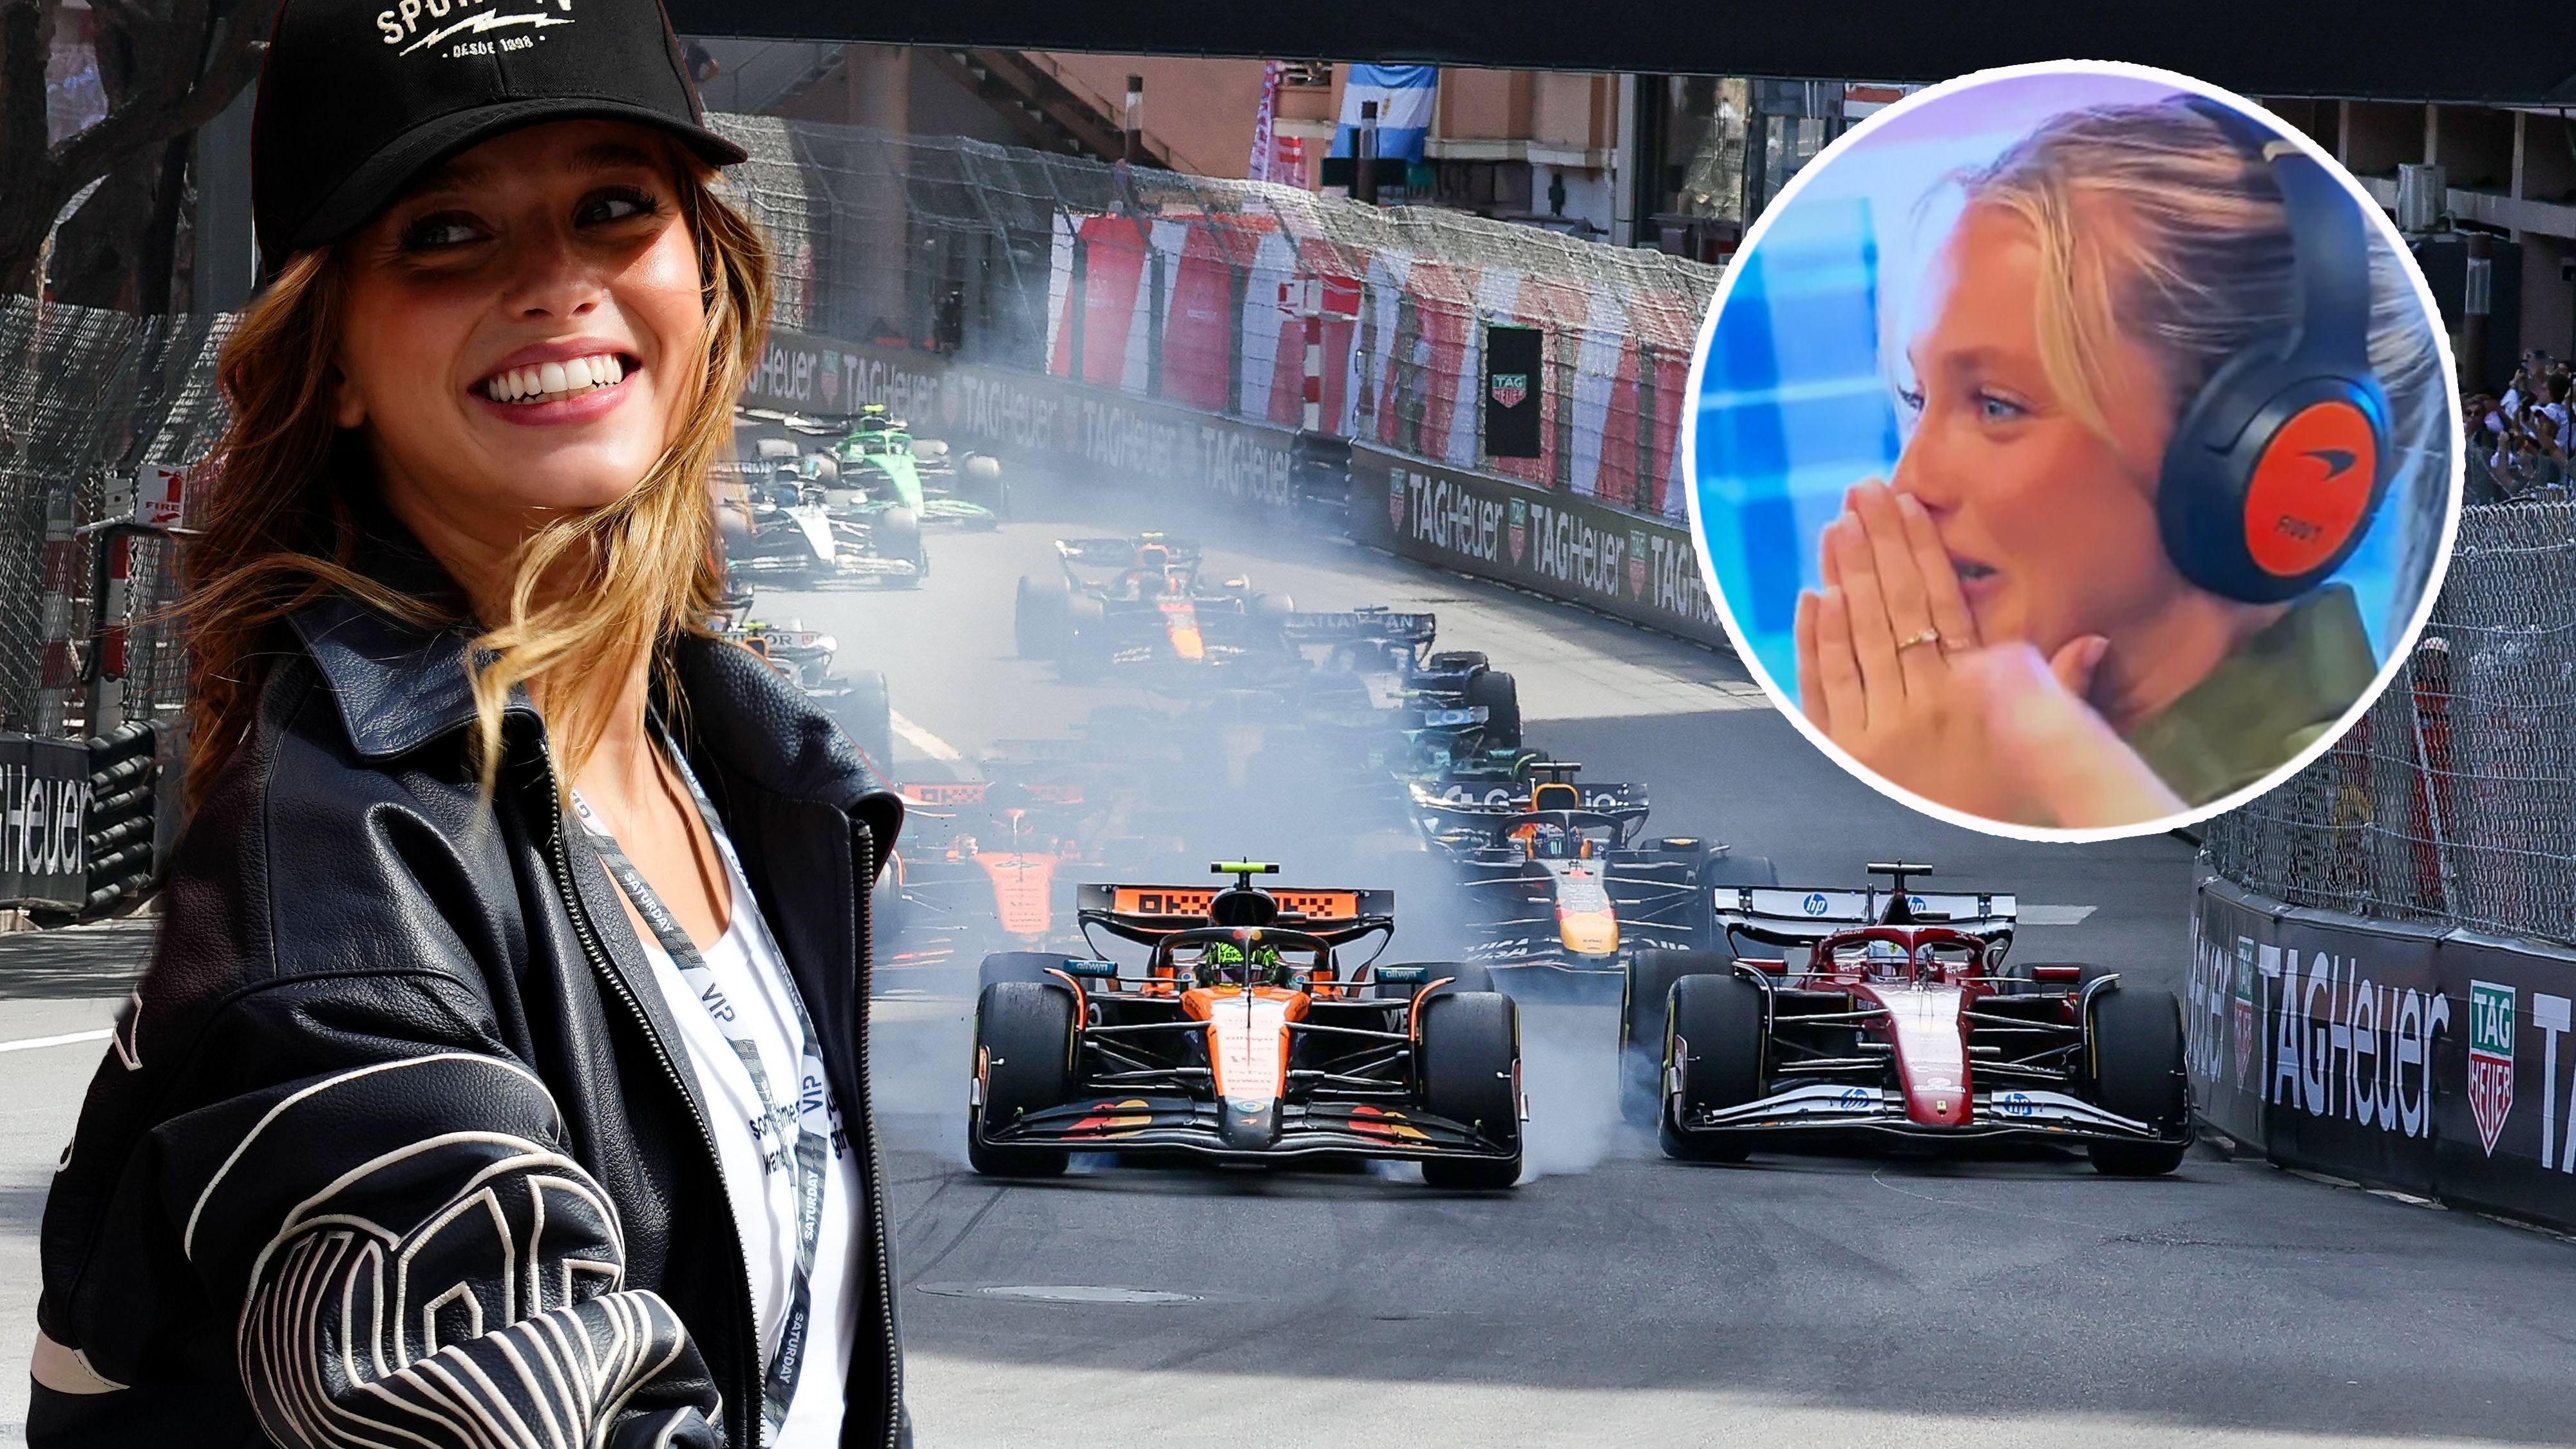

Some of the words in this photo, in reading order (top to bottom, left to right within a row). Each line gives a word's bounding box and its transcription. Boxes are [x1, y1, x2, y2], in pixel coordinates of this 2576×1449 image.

[1496, 377, 1524, 388] TAG
[145, 501, 180, 512] FIRE
[0, 762, 95, 875] Heuer
[622, 871, 674, 931] SATURDAY
[1805, 894, 1827, 916] hp
[1076, 961, 1108, 973] allwyn
[701, 981, 735, 1022] VIP
[2474, 992, 2511, 1049] TAG
[2258, 943, 2450, 1139] TAGHeuer
[802, 1075, 824, 1115] VIP
[2471, 1057, 2511, 1143] HEUER
[803, 1170, 819, 1241] SATURDAY
[779, 1312, 804, 1385] SATURDAY
